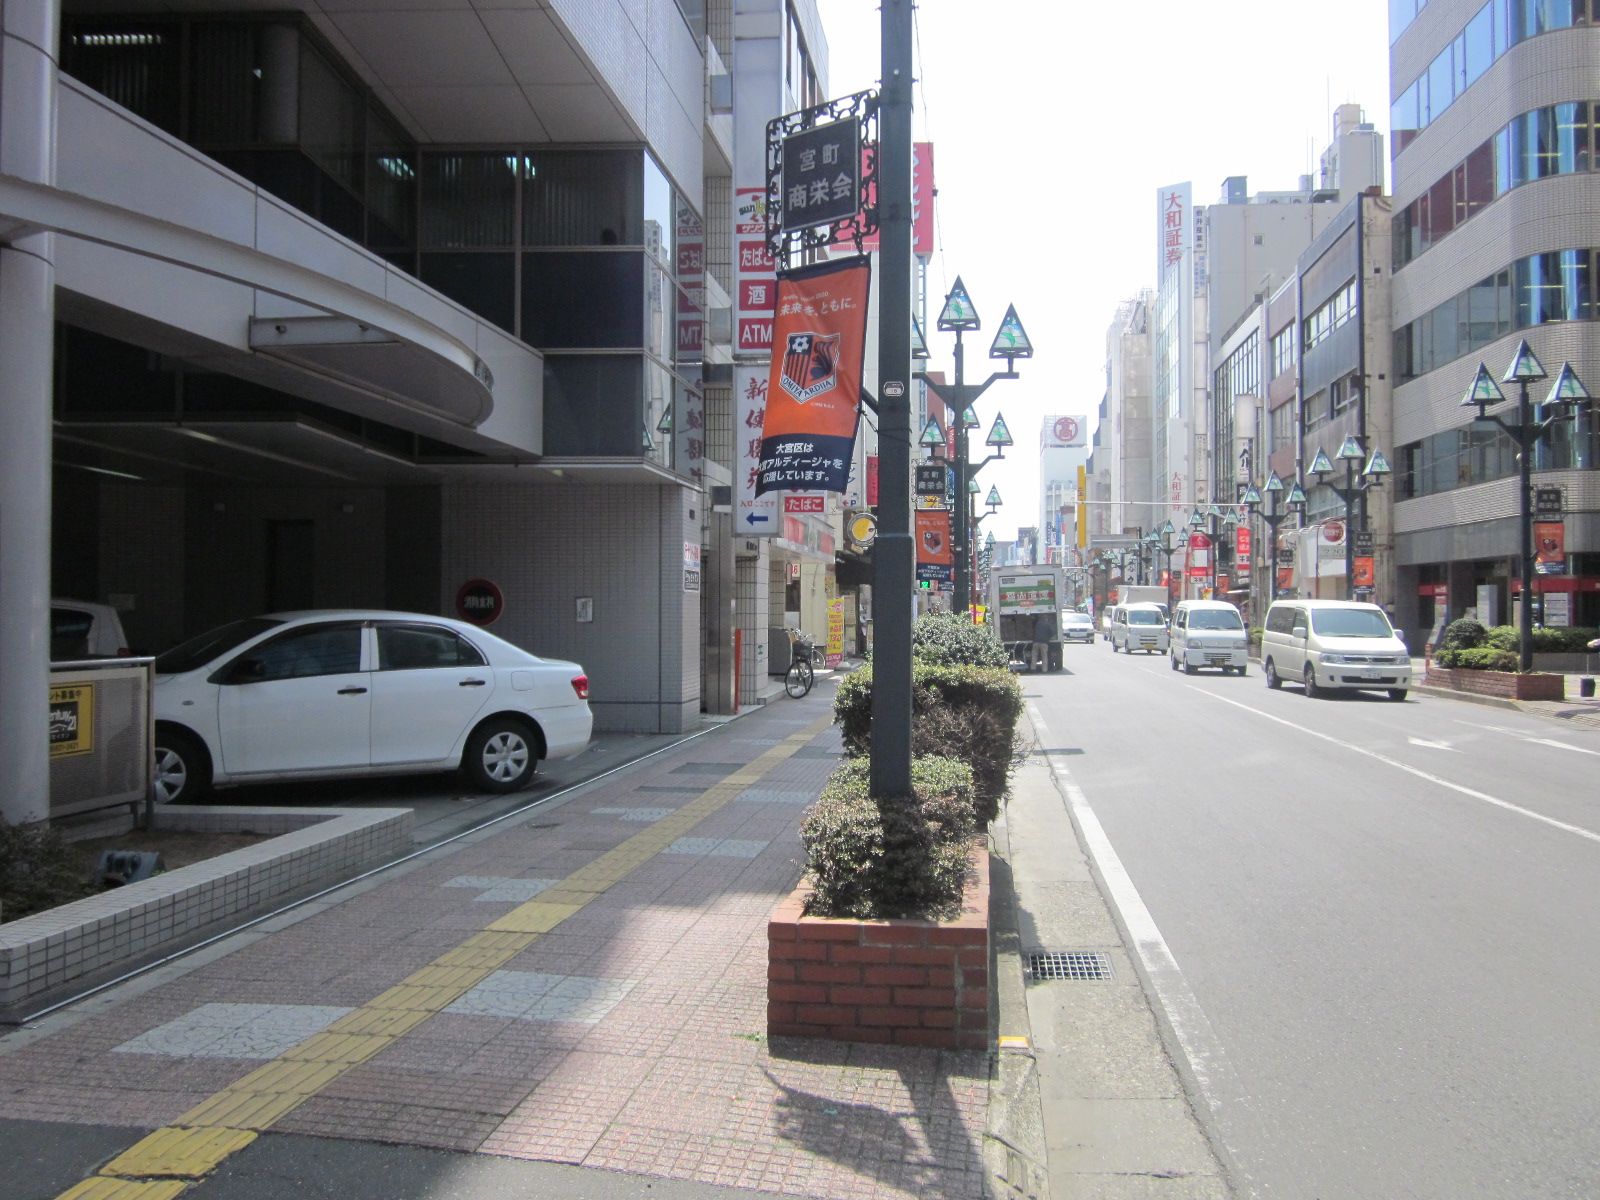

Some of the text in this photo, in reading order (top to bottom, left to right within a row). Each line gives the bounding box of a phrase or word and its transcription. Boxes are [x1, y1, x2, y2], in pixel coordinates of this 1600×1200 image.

[799, 143, 840, 173] 宮町
[787, 171, 853, 212] 商栄会
[1165, 191, 1184, 269] 大和証券
[747, 284, 766, 306] 酒
[741, 324, 773, 344] ATM
[782, 377, 803, 398] OMIYA
[775, 442, 815, 455] 大宮区は
[762, 470, 830, 485] 応援しています。
[788, 498, 823, 512] たばこ
